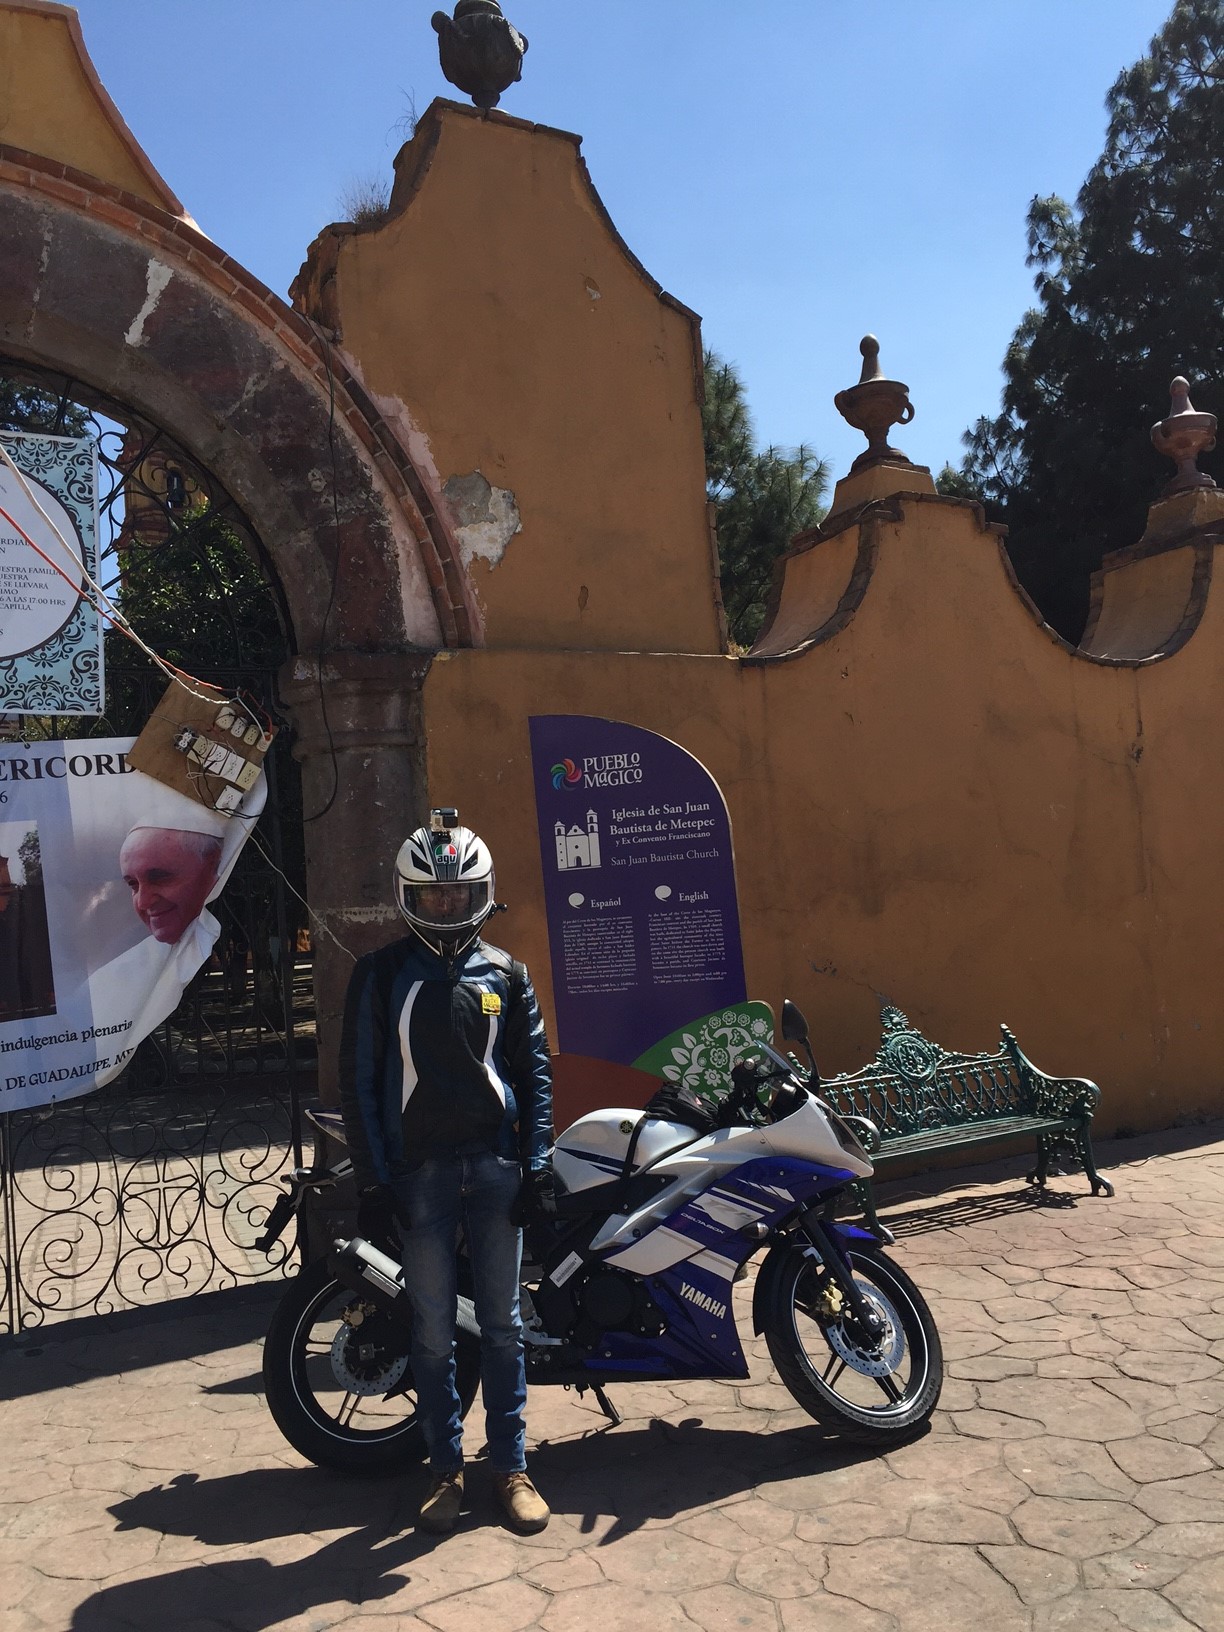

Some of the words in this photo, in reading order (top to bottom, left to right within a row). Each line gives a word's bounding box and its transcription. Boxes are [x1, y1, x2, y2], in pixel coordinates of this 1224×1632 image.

[15, 581, 49, 590] LLEVARA
[582, 752, 641, 773] PUEBLO
[612, 807, 646, 822] Iglesia
[648, 805, 661, 816] de
[663, 803, 682, 815] San
[684, 801, 711, 815] Juan
[609, 823, 653, 835] Bautista
[655, 820, 669, 831] de
[670, 818, 715, 831] Metepec
[615, 840, 622, 848] y
[621, 837, 632, 846] Ex
[632, 835, 667, 844] Convento
[668, 831, 711, 841] Franciscano
[611, 856, 627, 866] San
[628, 855, 649, 867] Juan
[650, 852, 685, 863] Bautista
[686, 847, 720, 860] Church
[590, 897, 622, 909] Español
[679, 890, 710, 903] English
[0, 1030, 79, 1053] indulgencia
[5, 1075, 27, 1091] DE
[679, 1282, 727, 1320] YAMAHA
